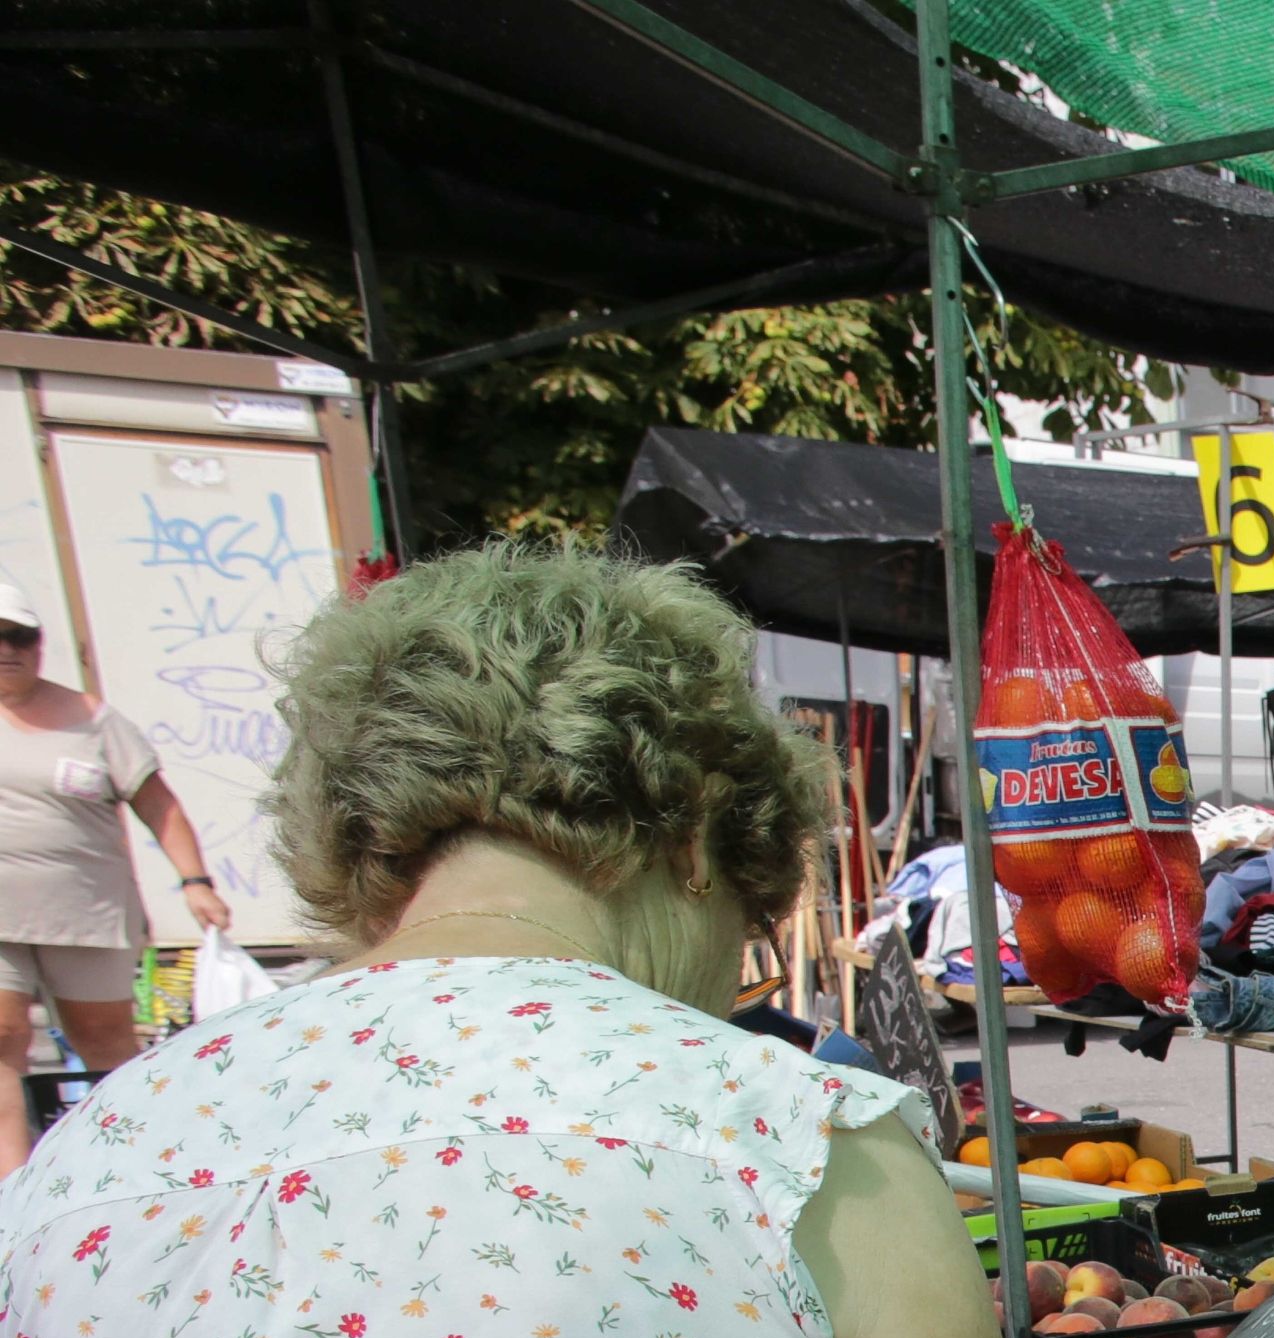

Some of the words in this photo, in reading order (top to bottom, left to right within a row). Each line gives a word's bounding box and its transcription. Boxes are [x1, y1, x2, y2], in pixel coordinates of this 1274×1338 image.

[1001, 758, 1125, 807] DEVESA
[1207, 1211, 1239, 1222] fruites
[1241, 1207, 1261, 1217] font
